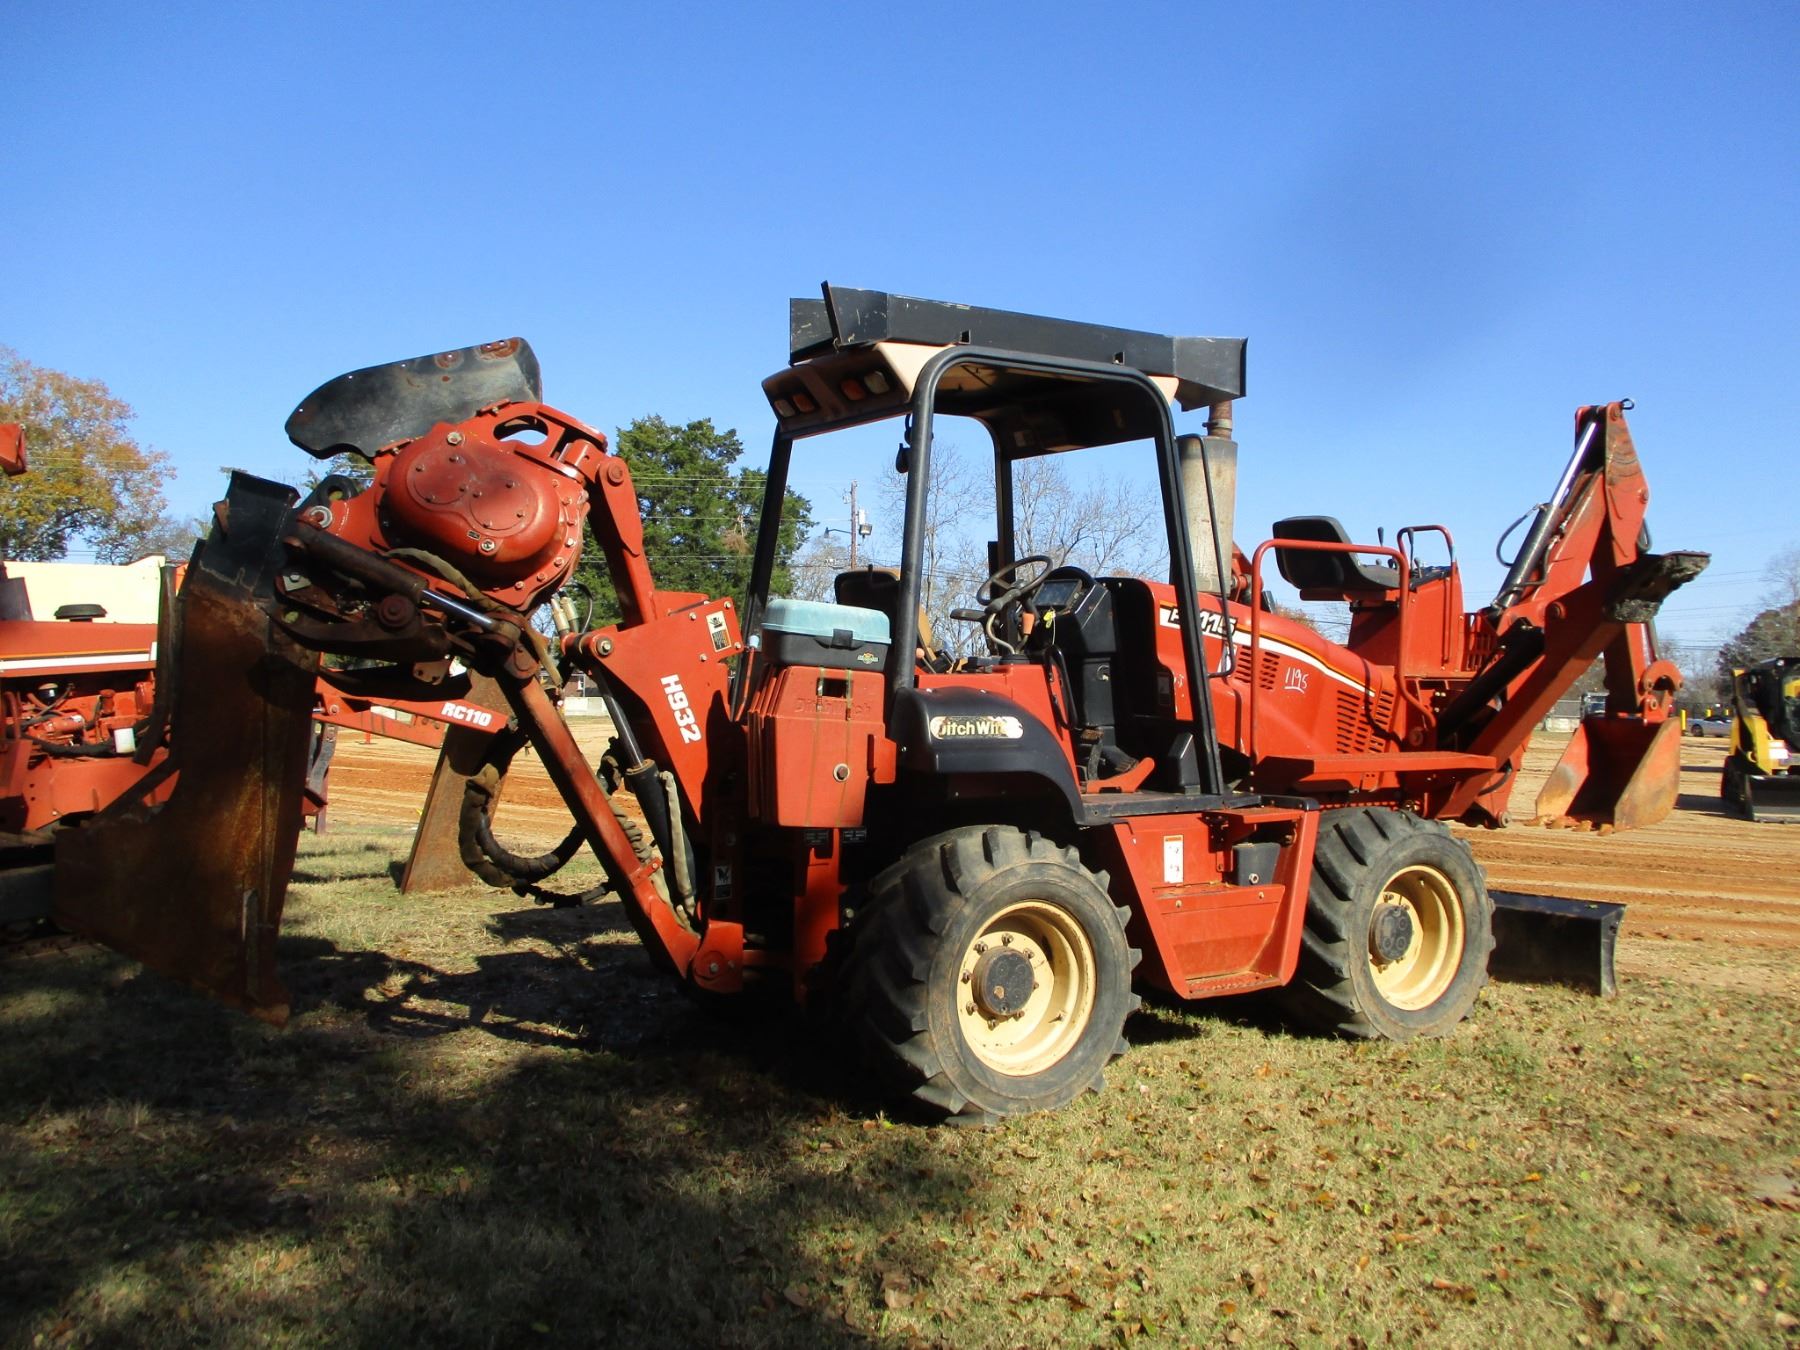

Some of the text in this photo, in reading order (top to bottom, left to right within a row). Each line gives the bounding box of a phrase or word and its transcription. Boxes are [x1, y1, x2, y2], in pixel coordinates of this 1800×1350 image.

[1284, 666, 1309, 690] 1195
[441, 701, 493, 727] RC110
[660, 674, 702, 744] H932
